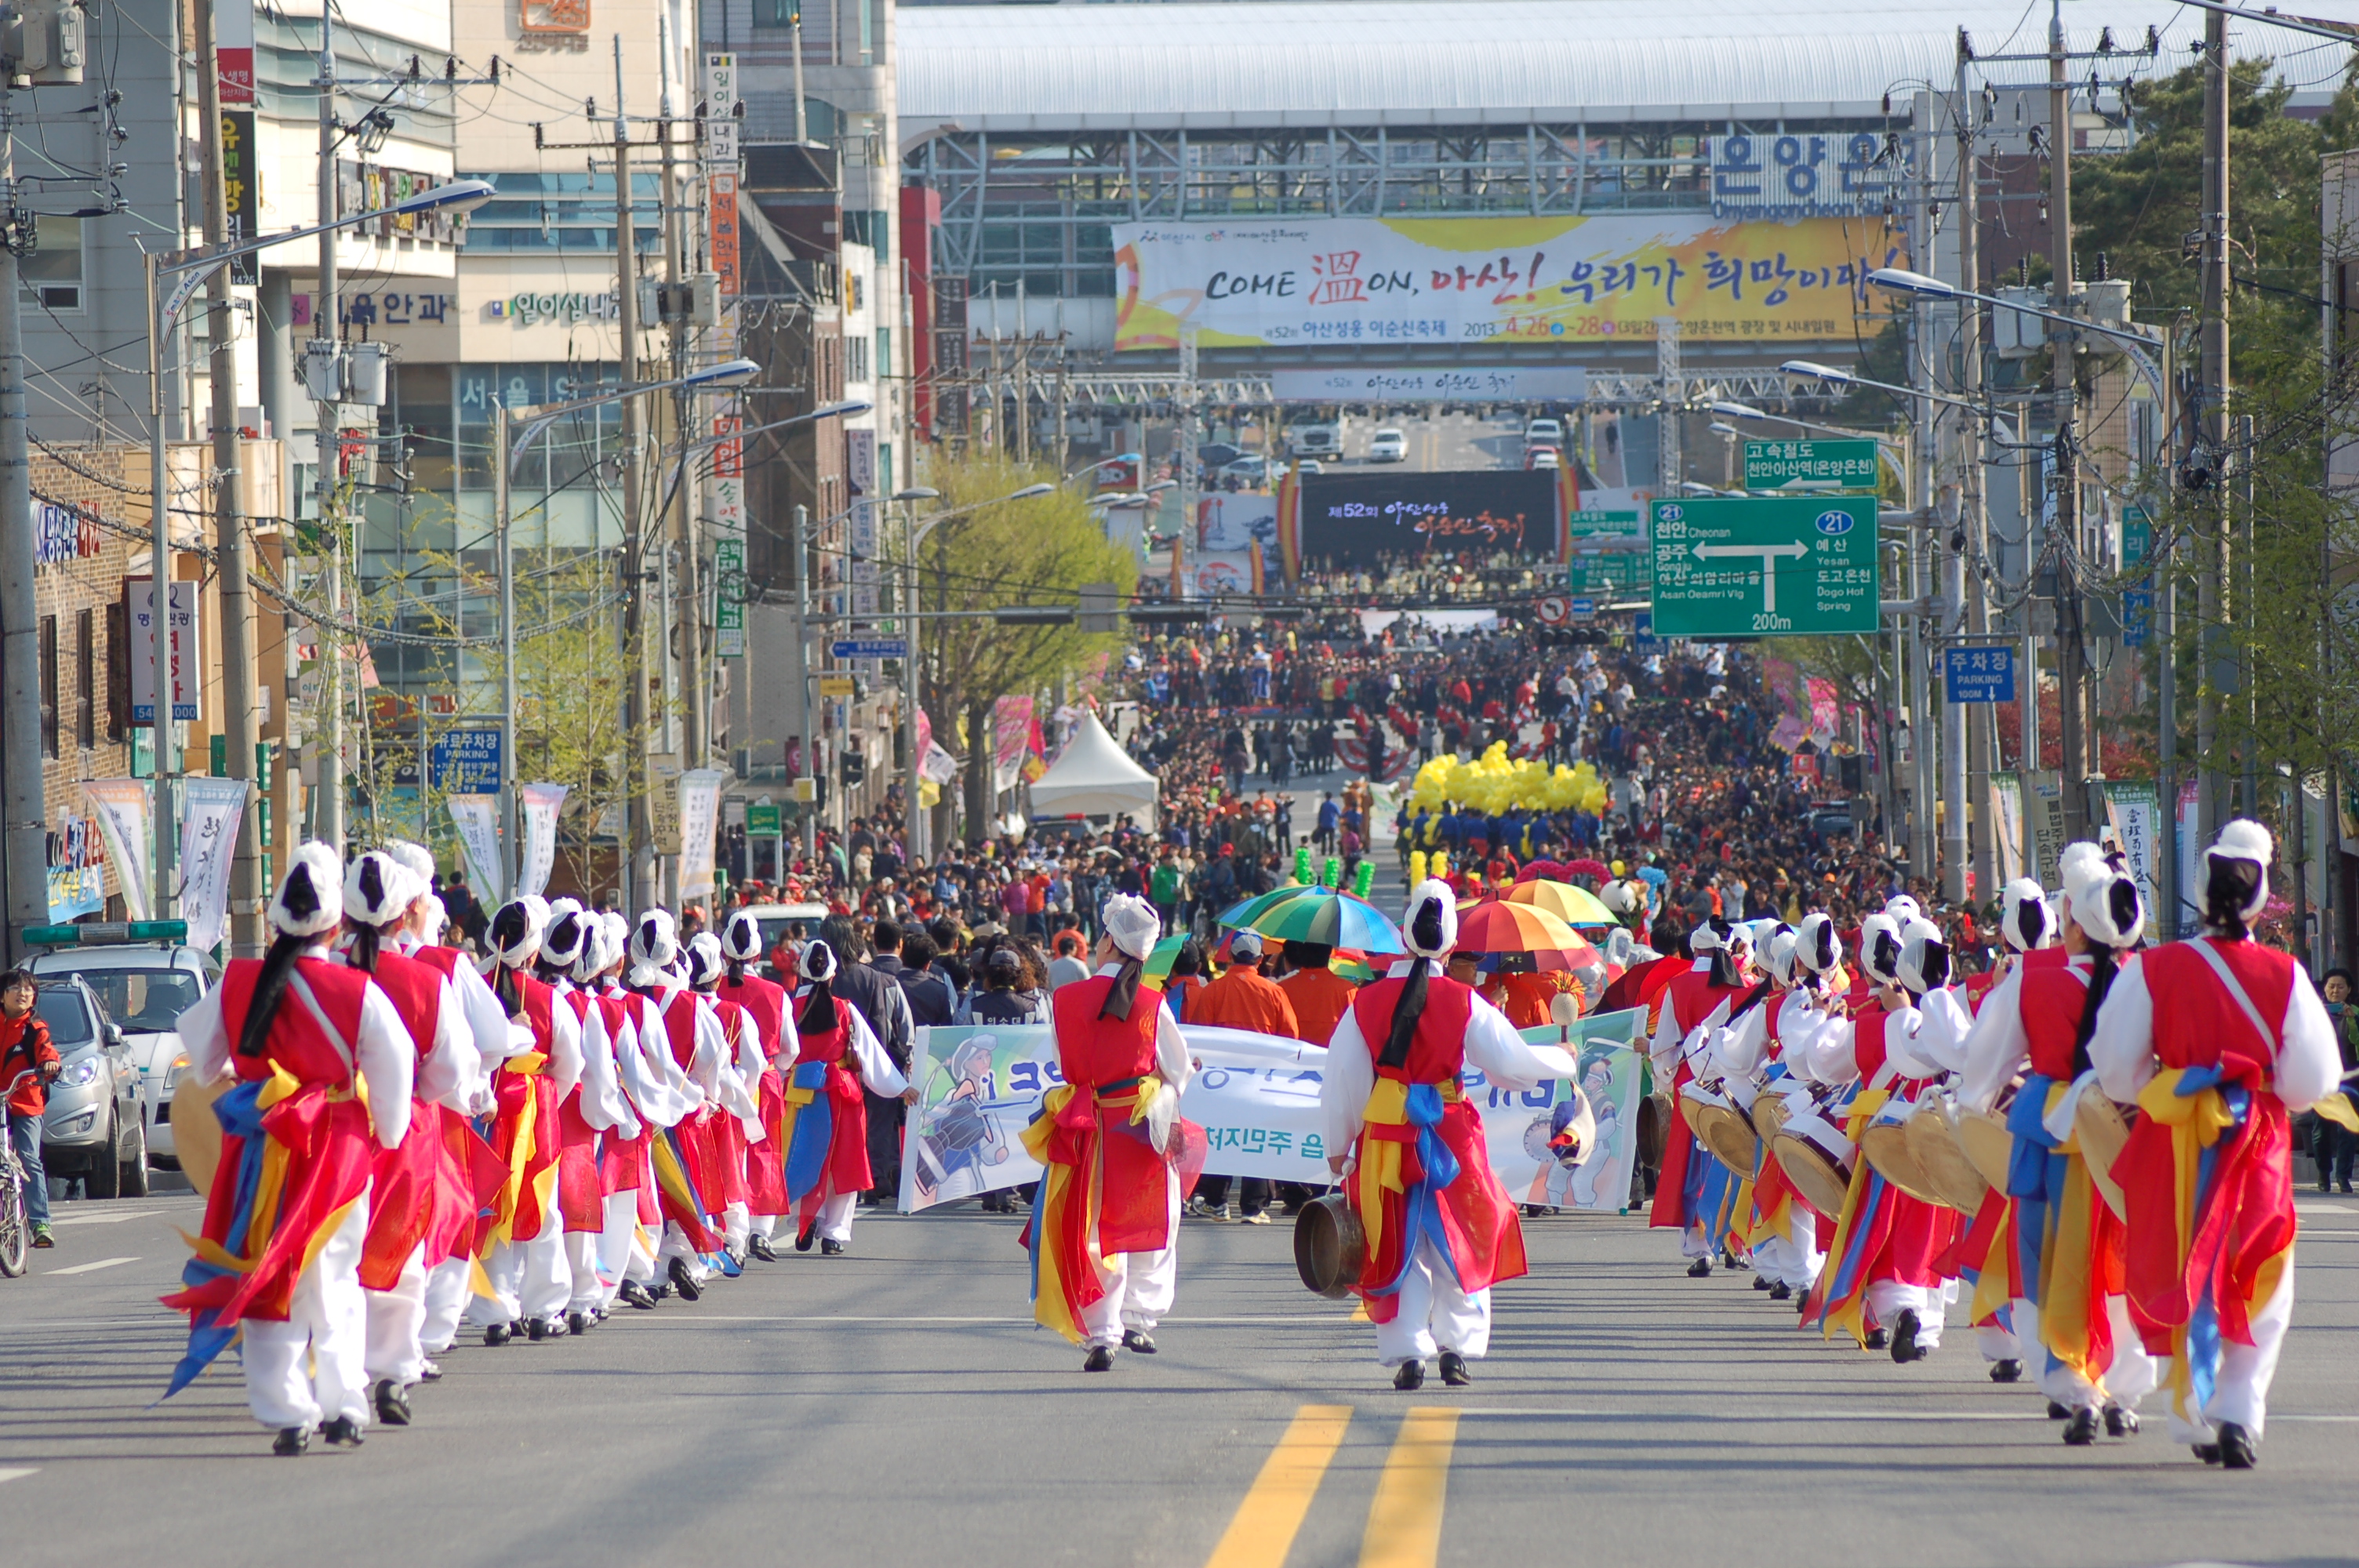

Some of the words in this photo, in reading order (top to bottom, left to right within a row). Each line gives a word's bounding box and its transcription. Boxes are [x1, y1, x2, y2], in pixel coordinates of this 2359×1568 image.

[1206, 270, 1296, 300] COME
[1432, 252, 1544, 305] 아산!
[1561, 258, 1685, 307] 우리가
[338, 293, 447, 324] 울안과
[1303, 319, 1363, 338] 아산성웅
[1369, 319, 1446, 338] 이순신축제
[1747, 443, 1815, 459] 고속철도
[1663, 506, 1680, 519] 21
[1656, 521, 1688, 539] 천안
[1688, 527, 1732, 539] Cheonan
[1824, 514, 1842, 532] 21
[1656, 543, 1688, 561] 공주
[1816, 539, 1848, 552] 예산
[1816, 557, 1850, 566] Yesan
[1659, 572, 1688, 586] 아산
[1816, 568, 1871, 583] 도고온천
[1659, 590, 1686, 600] Asan
[1816, 586, 1845, 598] Dogo
[1846, 587, 1864, 597] Hot
[1816, 602, 1851, 612] Spring
[137, 612, 190, 627] 명관광
[1752, 613, 1792, 631] 200m
[1950, 652, 2008, 672] 주차장
[1957, 674, 2004, 684] PARKING
[439, 733, 497, 750] 유료주차장
[445, 750, 489, 759] PARKING
[2037, 829, 2055, 882] 단속구역
